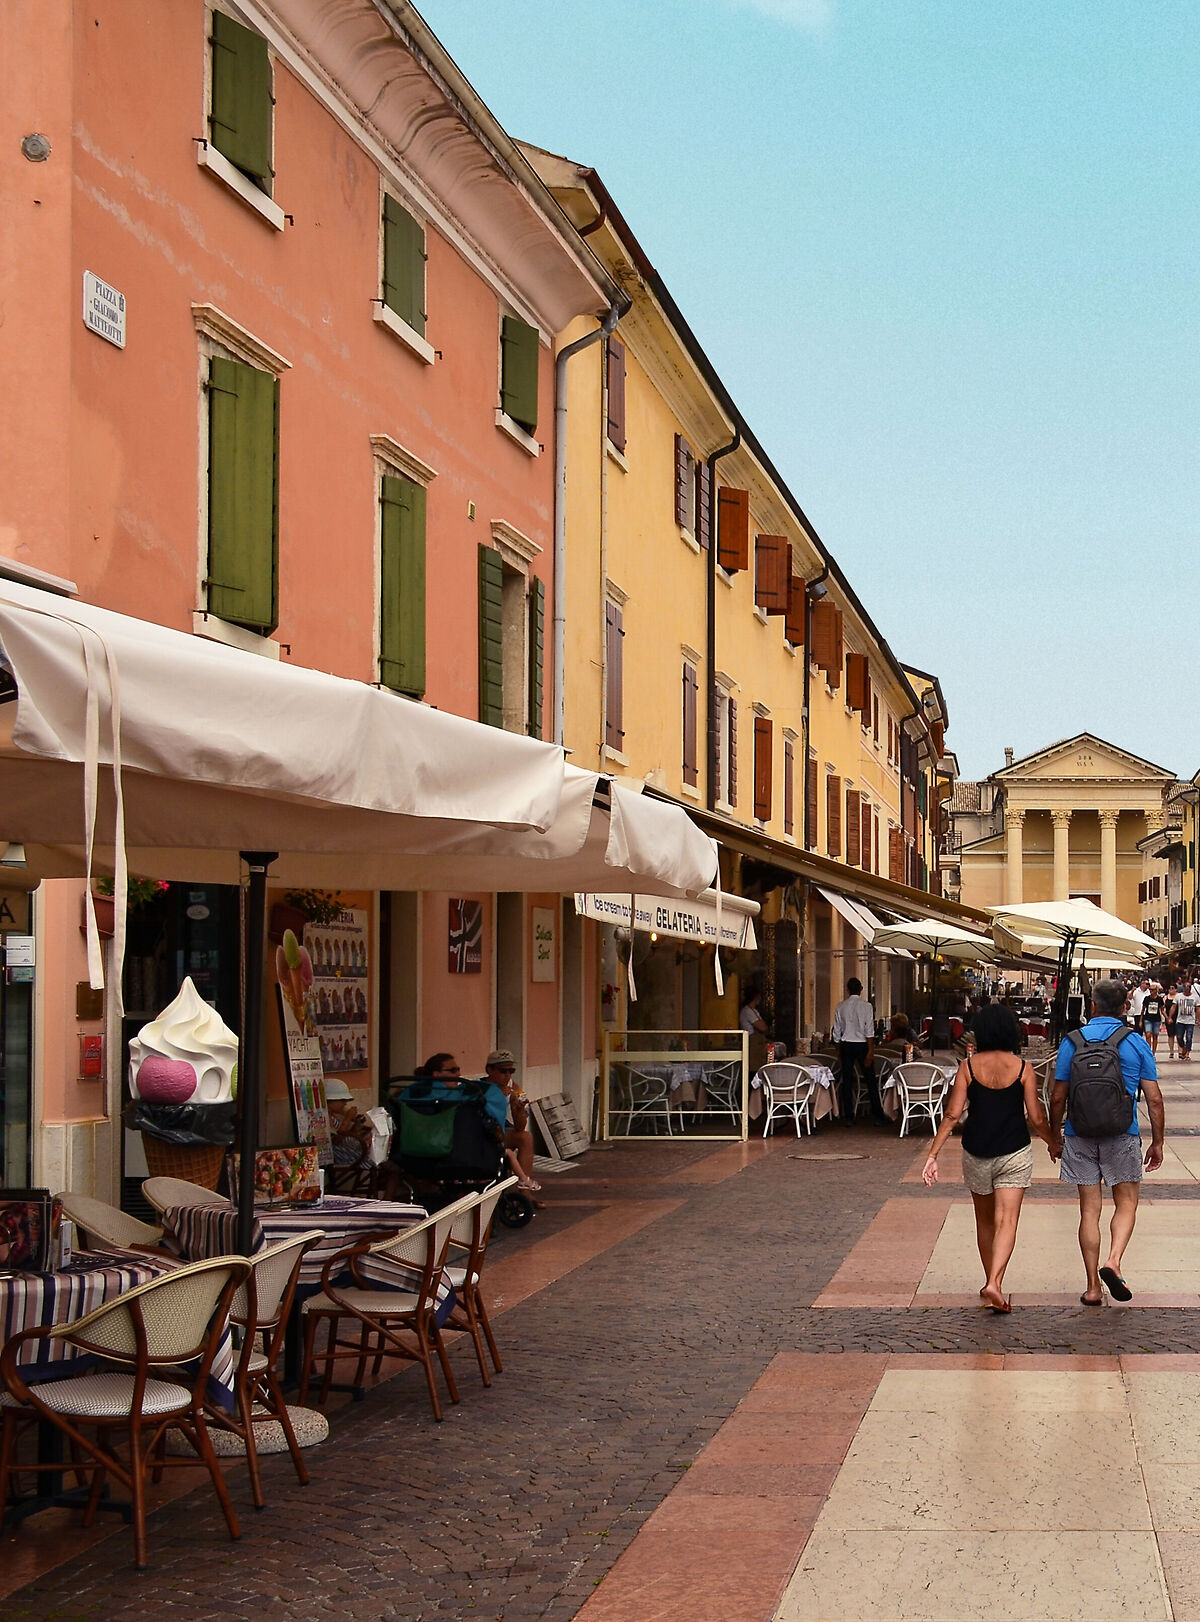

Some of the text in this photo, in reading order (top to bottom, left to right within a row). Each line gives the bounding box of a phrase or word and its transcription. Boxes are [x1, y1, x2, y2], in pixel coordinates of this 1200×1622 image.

[95, 281, 117, 307] PIAZZA
[89, 310, 122, 343] MATTEOTTI
[593, 894, 603, 912] Ice
[656, 906, 702, 935] GELATERIA
